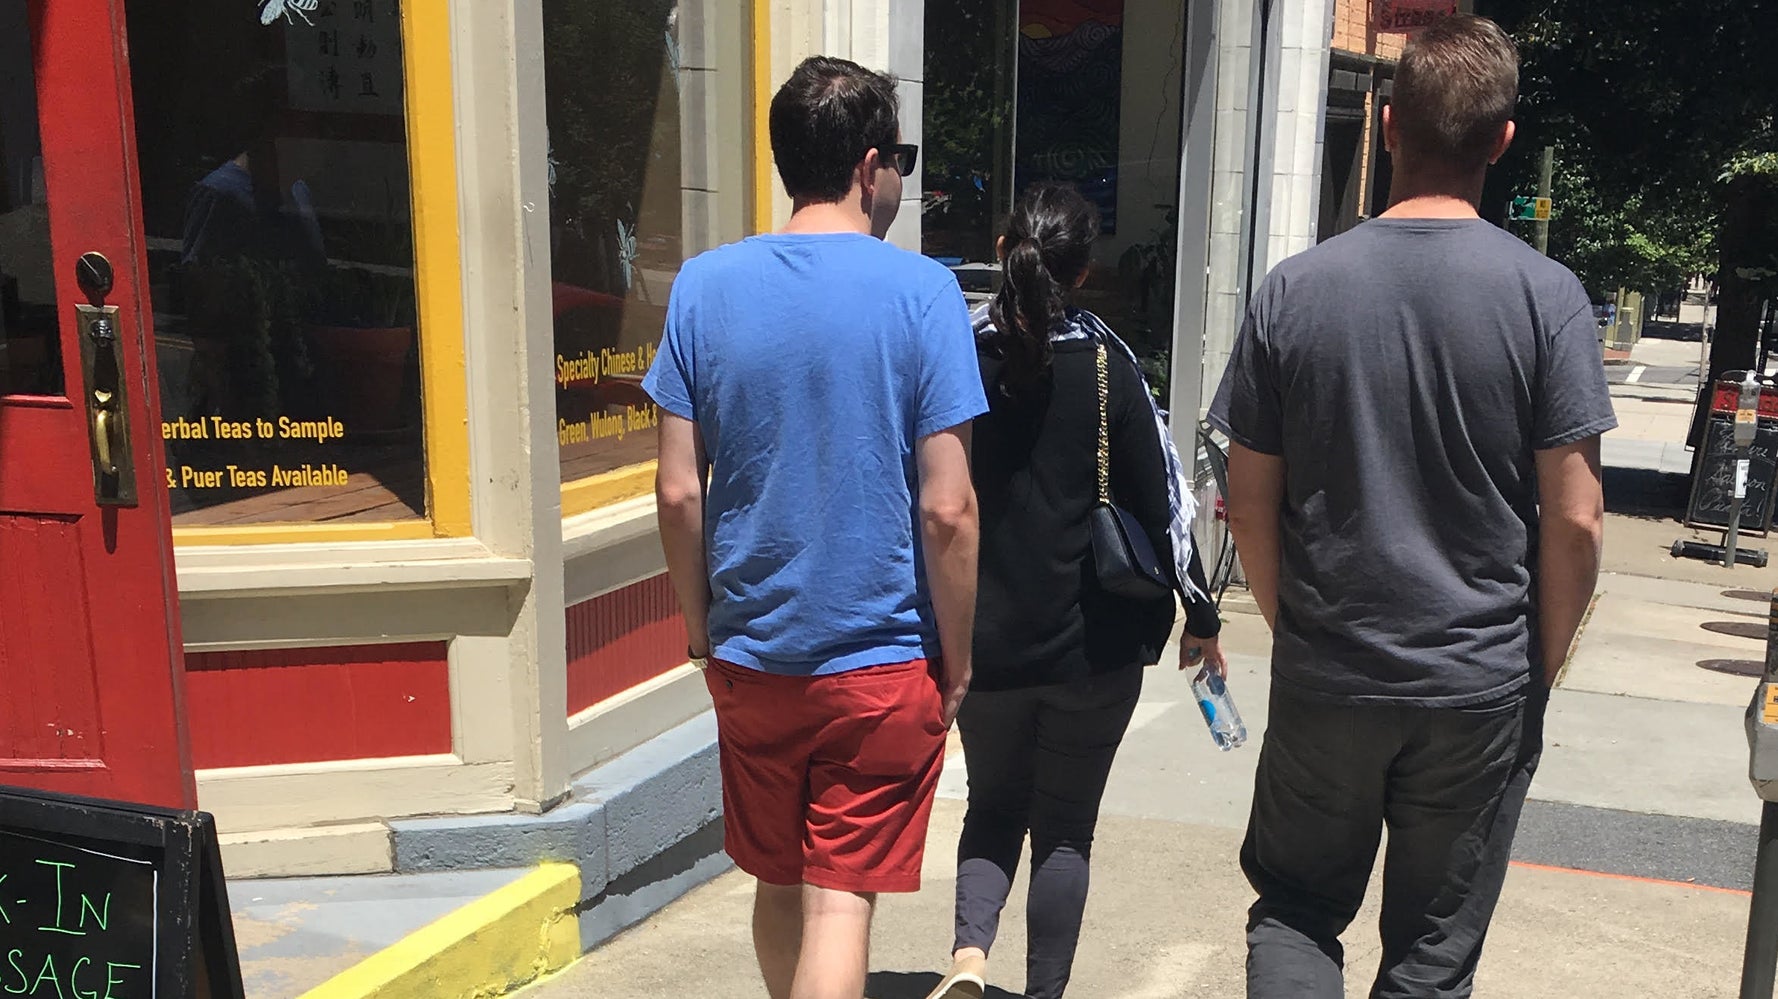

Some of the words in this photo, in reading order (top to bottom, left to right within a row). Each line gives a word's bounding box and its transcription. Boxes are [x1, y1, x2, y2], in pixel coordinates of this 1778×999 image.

[557, 350, 600, 390] Specialty
[601, 347, 636, 376] Chinese
[638, 345, 645, 371] &
[211, 416, 252, 439] Teas
[256, 417, 274, 439] to
[278, 416, 345, 444] Sample
[627, 403, 651, 432] Black
[181, 465, 223, 488] Puer
[226, 465, 267, 488] Teas
[271, 464, 348, 487] Available
[0, 949, 141, 999] SAGE
